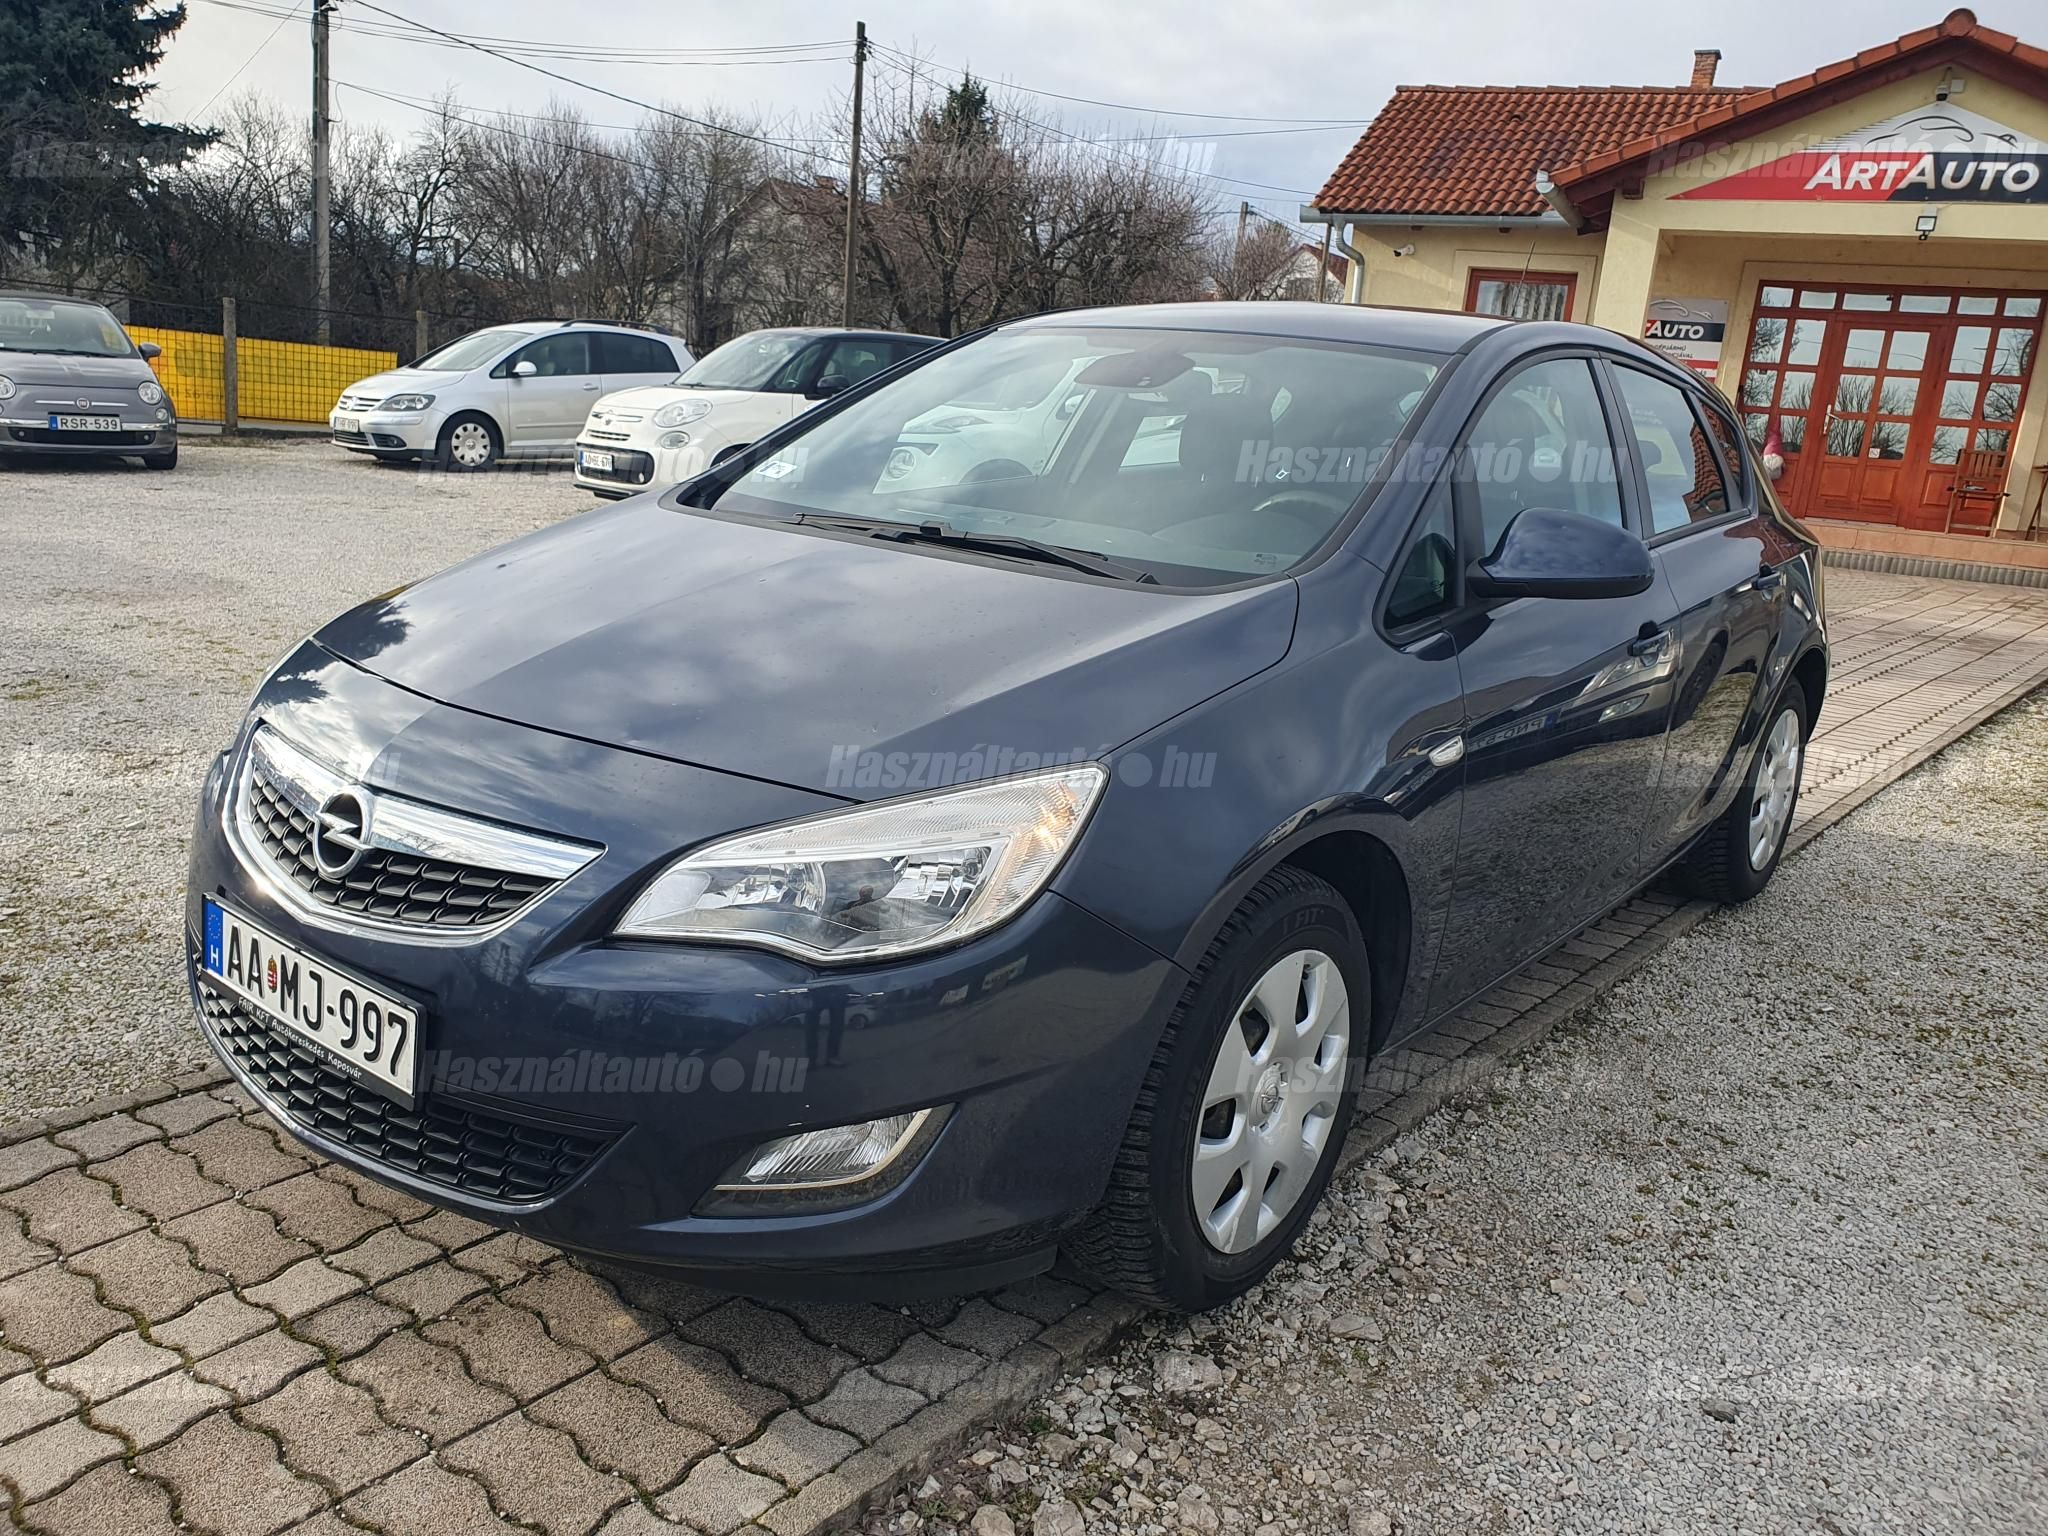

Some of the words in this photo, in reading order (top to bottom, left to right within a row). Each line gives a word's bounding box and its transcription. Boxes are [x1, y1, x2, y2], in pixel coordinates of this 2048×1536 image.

[1646, 320, 1704, 339] AUTO
[60, 417, 118, 430] RSR-539
[210, 945, 219, 967] H
[238, 996, 254, 1014] FAIR
[256, 1005, 270, 1023] KFT
[271, 1017, 325, 1059] Autókereskedés
[327, 1050, 362, 1080] Kaposvár
